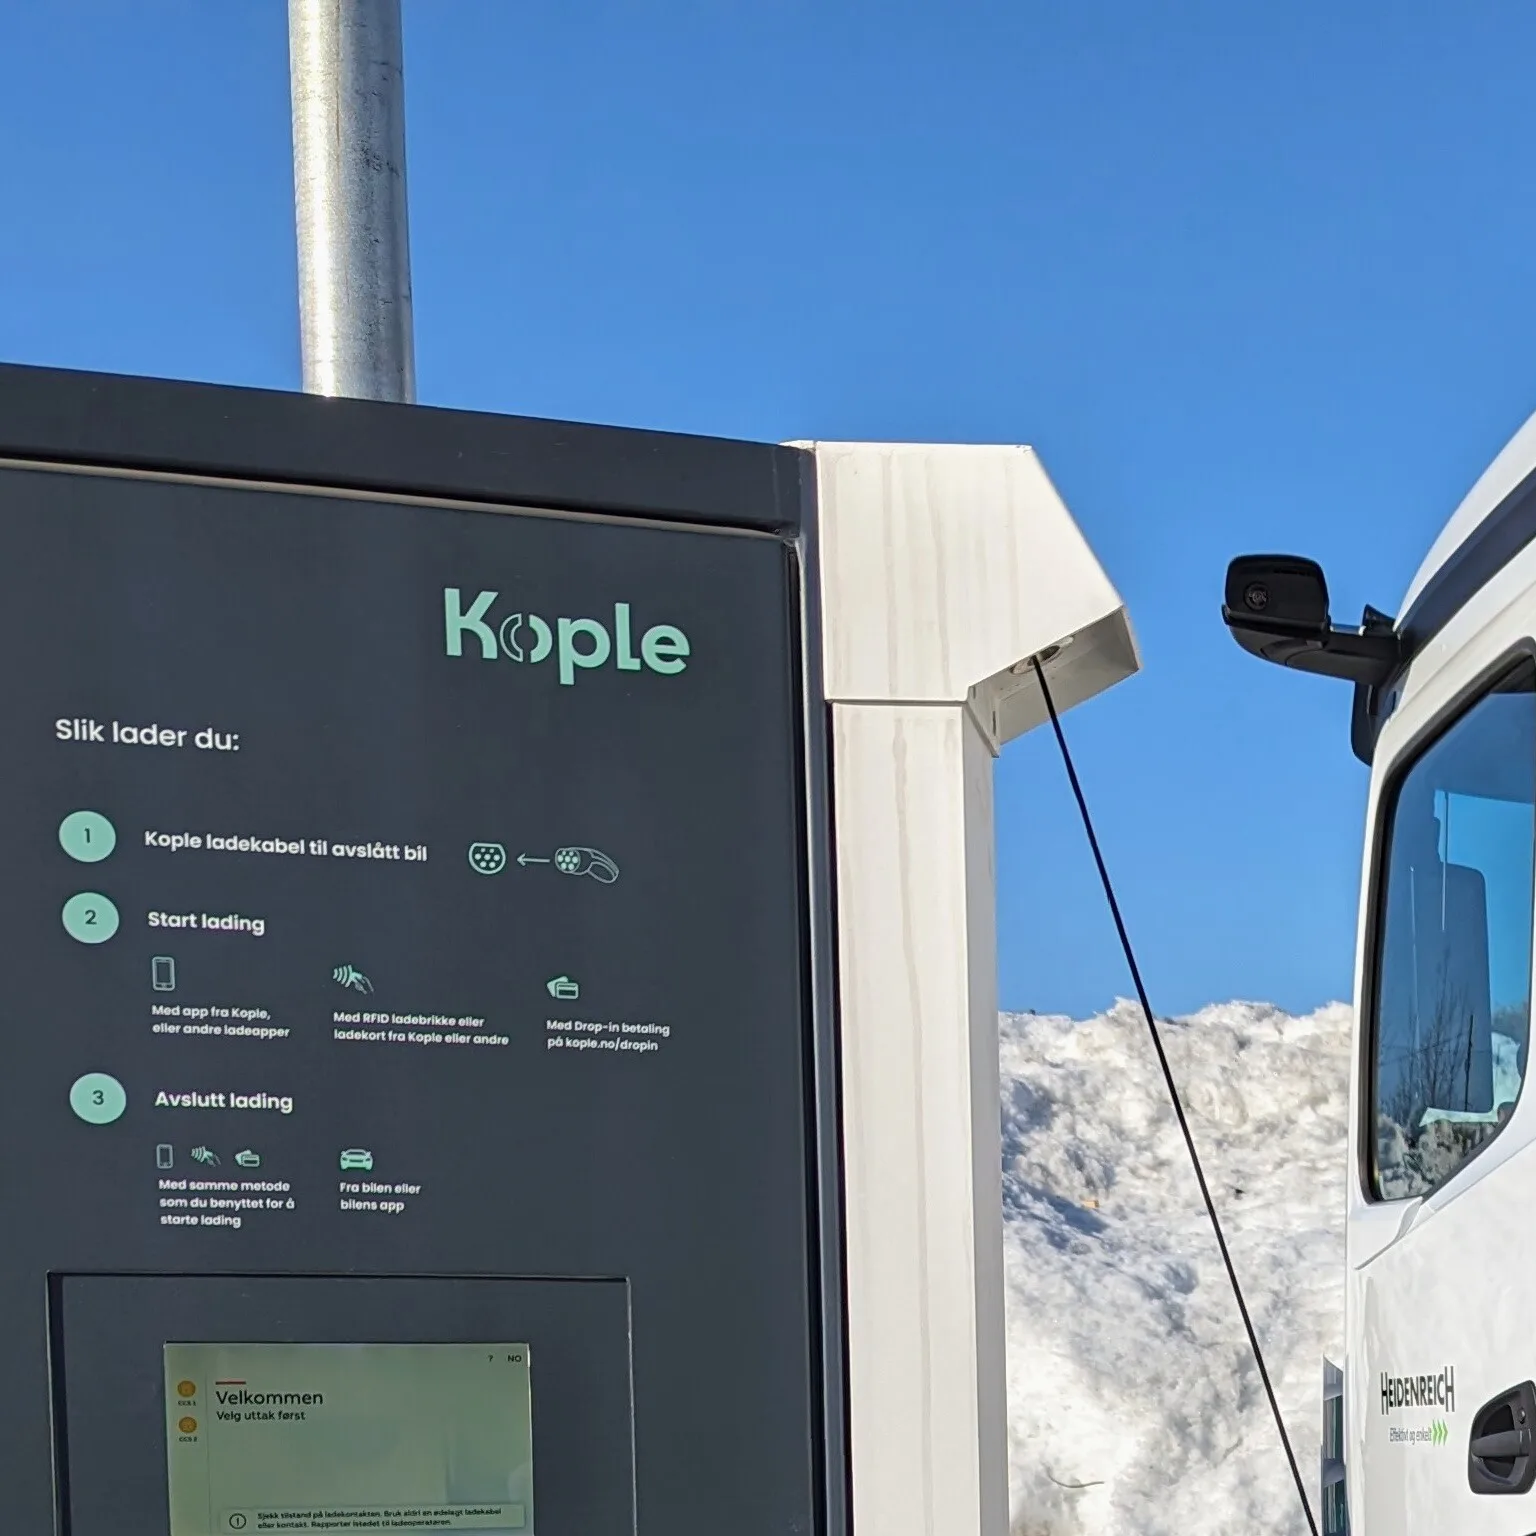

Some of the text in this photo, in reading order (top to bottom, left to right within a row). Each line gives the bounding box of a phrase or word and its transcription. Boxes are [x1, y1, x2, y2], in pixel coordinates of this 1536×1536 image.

[443, 588, 690, 684] Kople
[55, 718, 240, 751] Slik lader du:
[83, 828, 92, 843] 1
[145, 830, 428, 862] Kople ladekabel til avslått bil
[84, 909, 98, 925] 2
[148, 911, 265, 936] Start lading
[152, 1005, 271, 1021] Med app fra Kople,
[333, 1012, 485, 1027] Med RFID ladebrikke eller
[152, 1022, 290, 1040] eller andre ladeapper
[546, 1020, 670, 1037] Med Drop-in betaling
[334, 1029, 509, 1046] ladekort fra Kople eller andre
[547, 1036, 659, 1053] på kople.no/dropin
[92, 1089, 104, 1106] 3
[154, 1091, 293, 1114] Avslutt lading
[159, 1179, 290, 1192] Med samme metode
[340, 1182, 421, 1194] Fra bilen eller
[160, 1197, 295, 1211] som du benyttet for å
[340, 1198, 405, 1214] bilens app
[160, 1214, 241, 1229] starte lading
[507, 1354, 522, 1363] NO
[215, 1390, 323, 1405] Velkommen
[1380, 1366, 1455, 1415] HEIDENREICH
[216, 1410, 306, 1422] Velg uttak først
